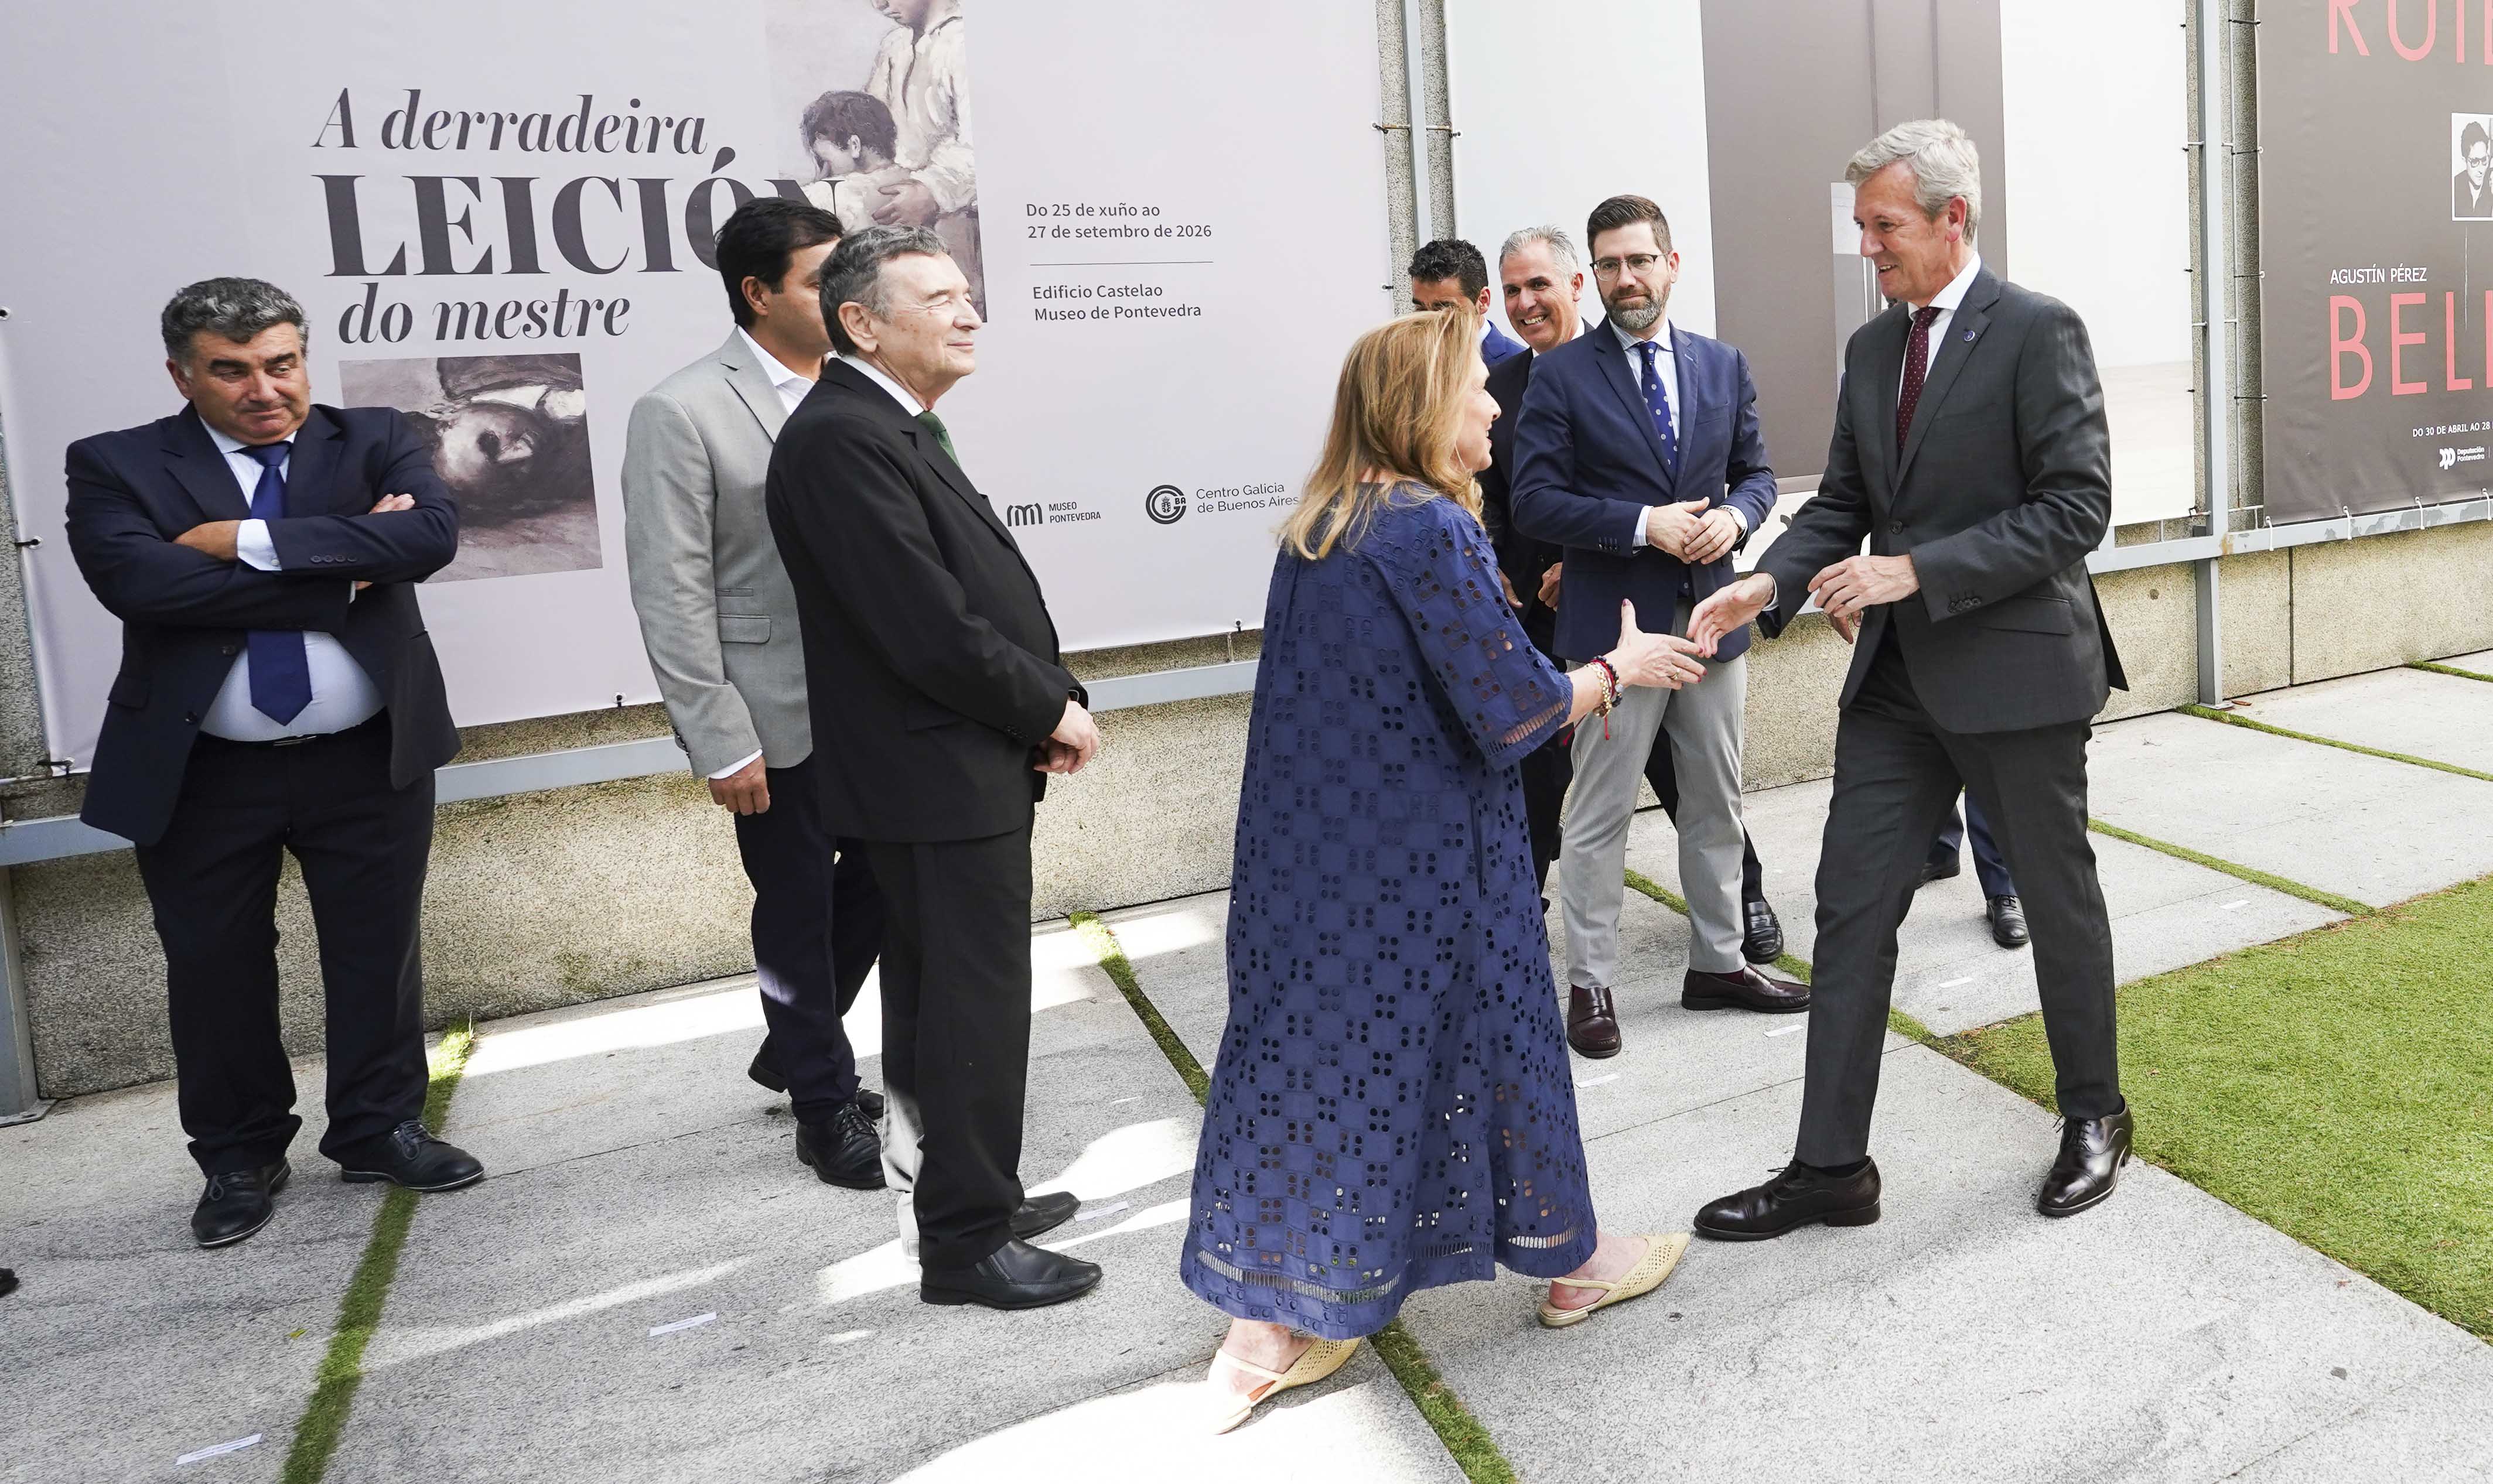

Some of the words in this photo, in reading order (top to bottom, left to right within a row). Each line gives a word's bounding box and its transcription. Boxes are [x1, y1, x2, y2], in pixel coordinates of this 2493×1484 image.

[311, 87, 359, 148] A
[381, 89, 708, 155] derradeira
[1026, 203, 1048, 217] Do
[1051, 204, 1071, 217] 25
[1075, 203, 1095, 217] de
[1099, 202, 1138, 216] xuño
[1142, 206, 1160, 216] ao
[1027, 225, 1046, 238] 27
[1051, 224, 1071, 238] de
[1075, 224, 1150, 238] setembro
[1154, 224, 1172, 238] de
[1176, 225, 1212, 237] 2026
[2330, 264, 2385, 284] AGUSTÍN
[2390, 263, 2427, 283] PÉREZ
[1033, 285, 1092, 299] Edificio
[1097, 283, 1163, 298] Castelao
[339, 282, 413, 344] do
[432, 288, 630, 341] mestre
[1034, 308, 1086, 321] Museo
[1091, 306, 1109, 319] de
[1114, 303, 1201, 319] Pontevedra
[2412, 428, 2424, 437] DO
[2425, 426, 2434, 436] 30
[2436, 425, 2447, 435] DE
[2447, 423, 2468, 433] ABRIL
[2470, 422, 2480, 432] AO
[2481, 421, 2491, 430] 28
[1196, 487, 1239, 500] Centro
[1242, 482, 1285, 495] Galicia
[1049, 501, 1077, 512] MUSEO
[1174, 497, 1186, 505] BA
[1197, 502, 1214, 514] de
[1218, 500, 1266, 512] Buenos
[1268, 495, 1299, 508] Aires
[1049, 510, 1101, 524] PONTEVEDRA
